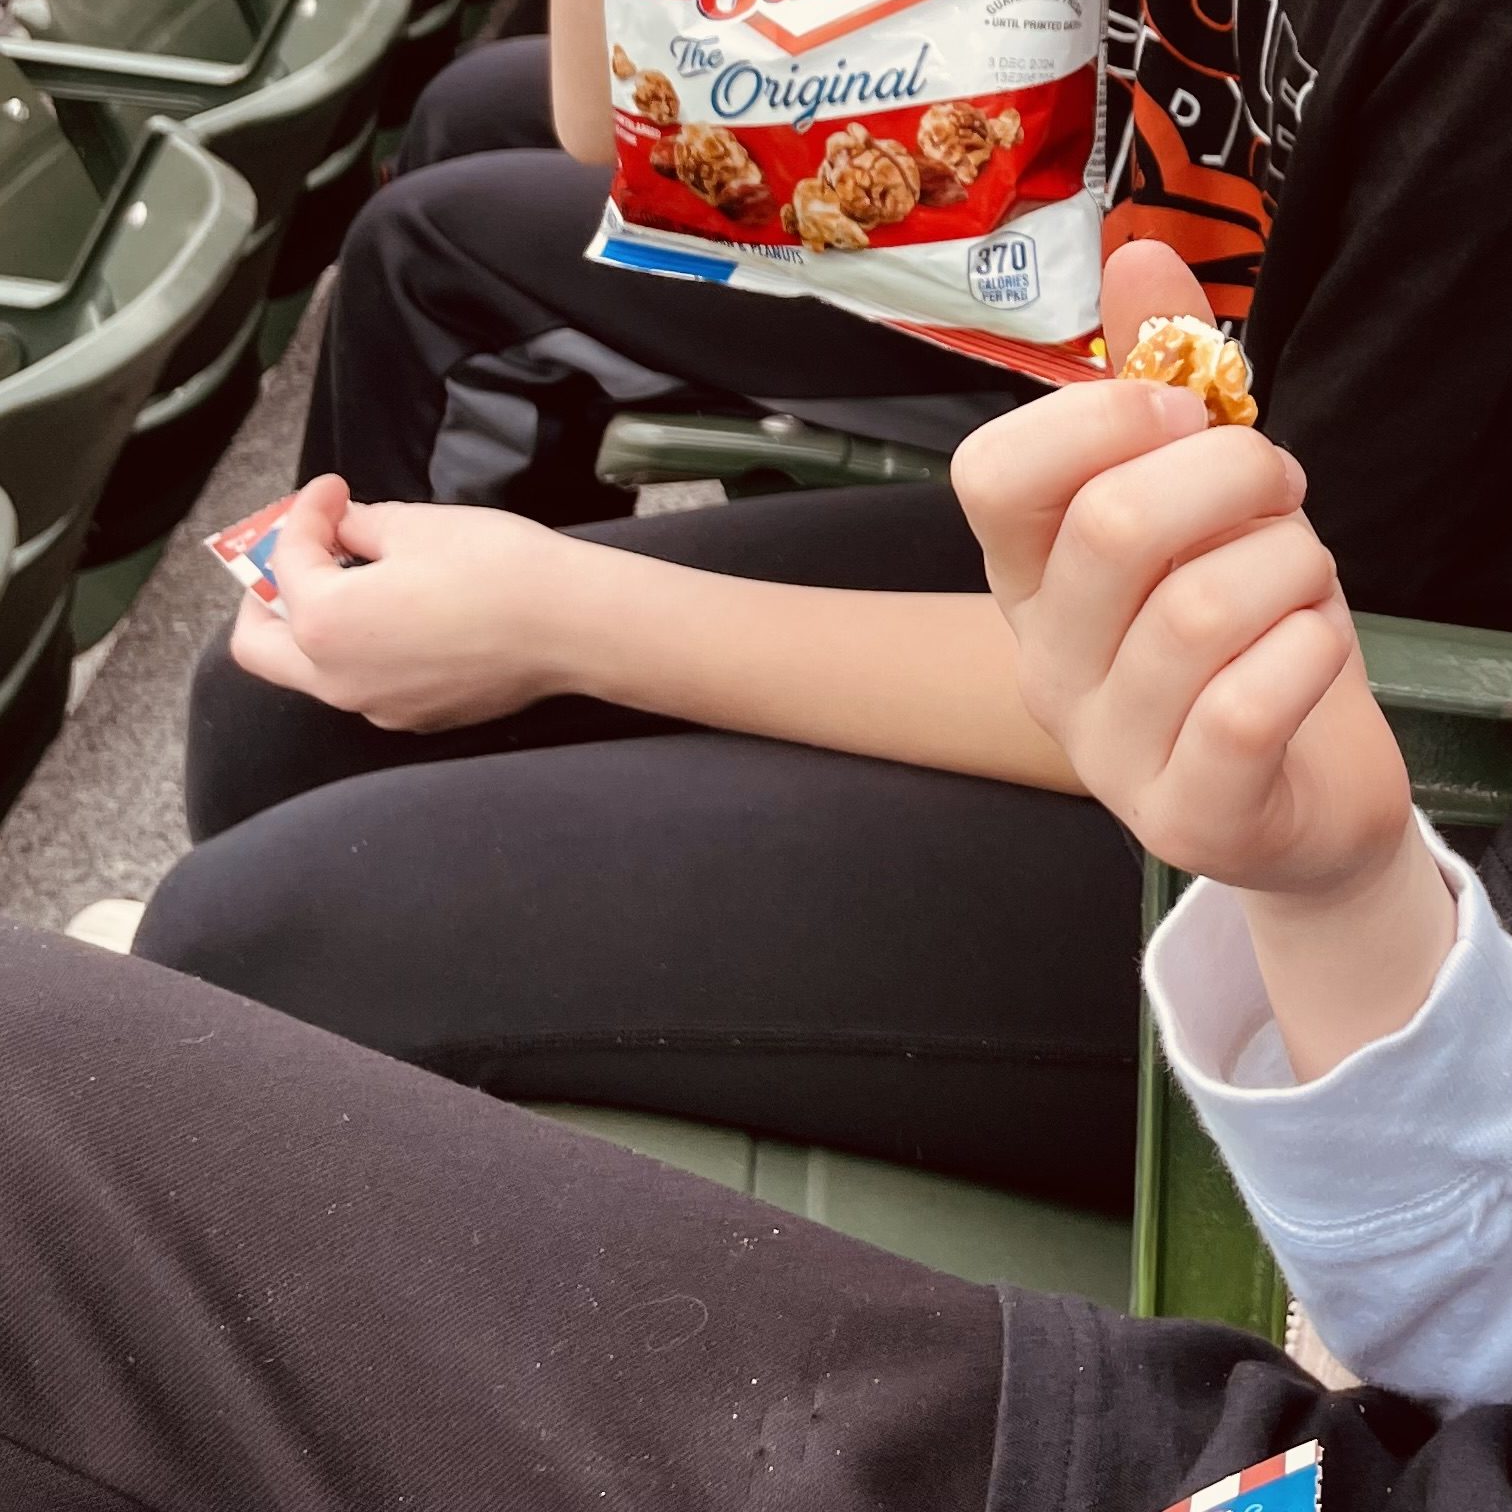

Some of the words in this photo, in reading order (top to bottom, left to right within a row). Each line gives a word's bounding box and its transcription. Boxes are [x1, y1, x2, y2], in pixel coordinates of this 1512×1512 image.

[992, 18, 1020, 29] UNTIL
[1023, 20, 1062, 30] PRINTED
[670, 35, 725, 77] The
[999, 57, 1026, 69] DEC
[711, 43, 930, 133] Original
[751, 244, 805, 265] PEANUTS
[976, 242, 1027, 275] 370
[978, 274, 1030, 289] CALORIES
[982, 288, 1003, 302] PER
[1007, 288, 1028, 302] PKG
